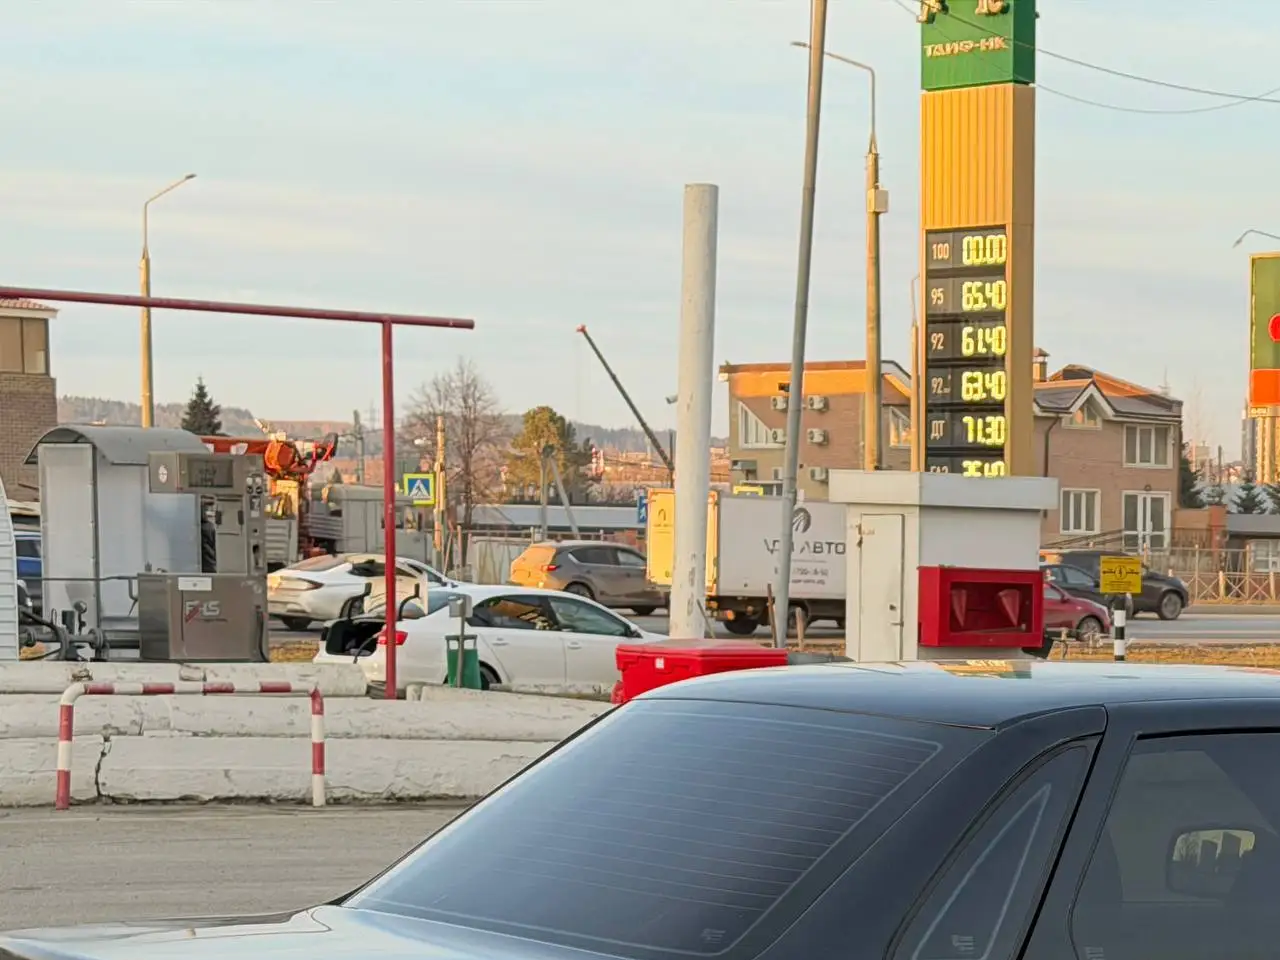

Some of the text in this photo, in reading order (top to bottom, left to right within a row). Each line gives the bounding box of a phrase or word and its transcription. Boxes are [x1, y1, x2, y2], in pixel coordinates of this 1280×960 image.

[924, 36, 1008, 57] ТАИФ-НК
[932, 234, 1007, 265] 100 00.00
[931, 280, 1007, 311] 95 65.40
[931, 326, 1007, 356] 92 61.40
[931, 371, 1006, 401] 92 63.40
[930, 416, 1005, 446] ДТ 71.30
